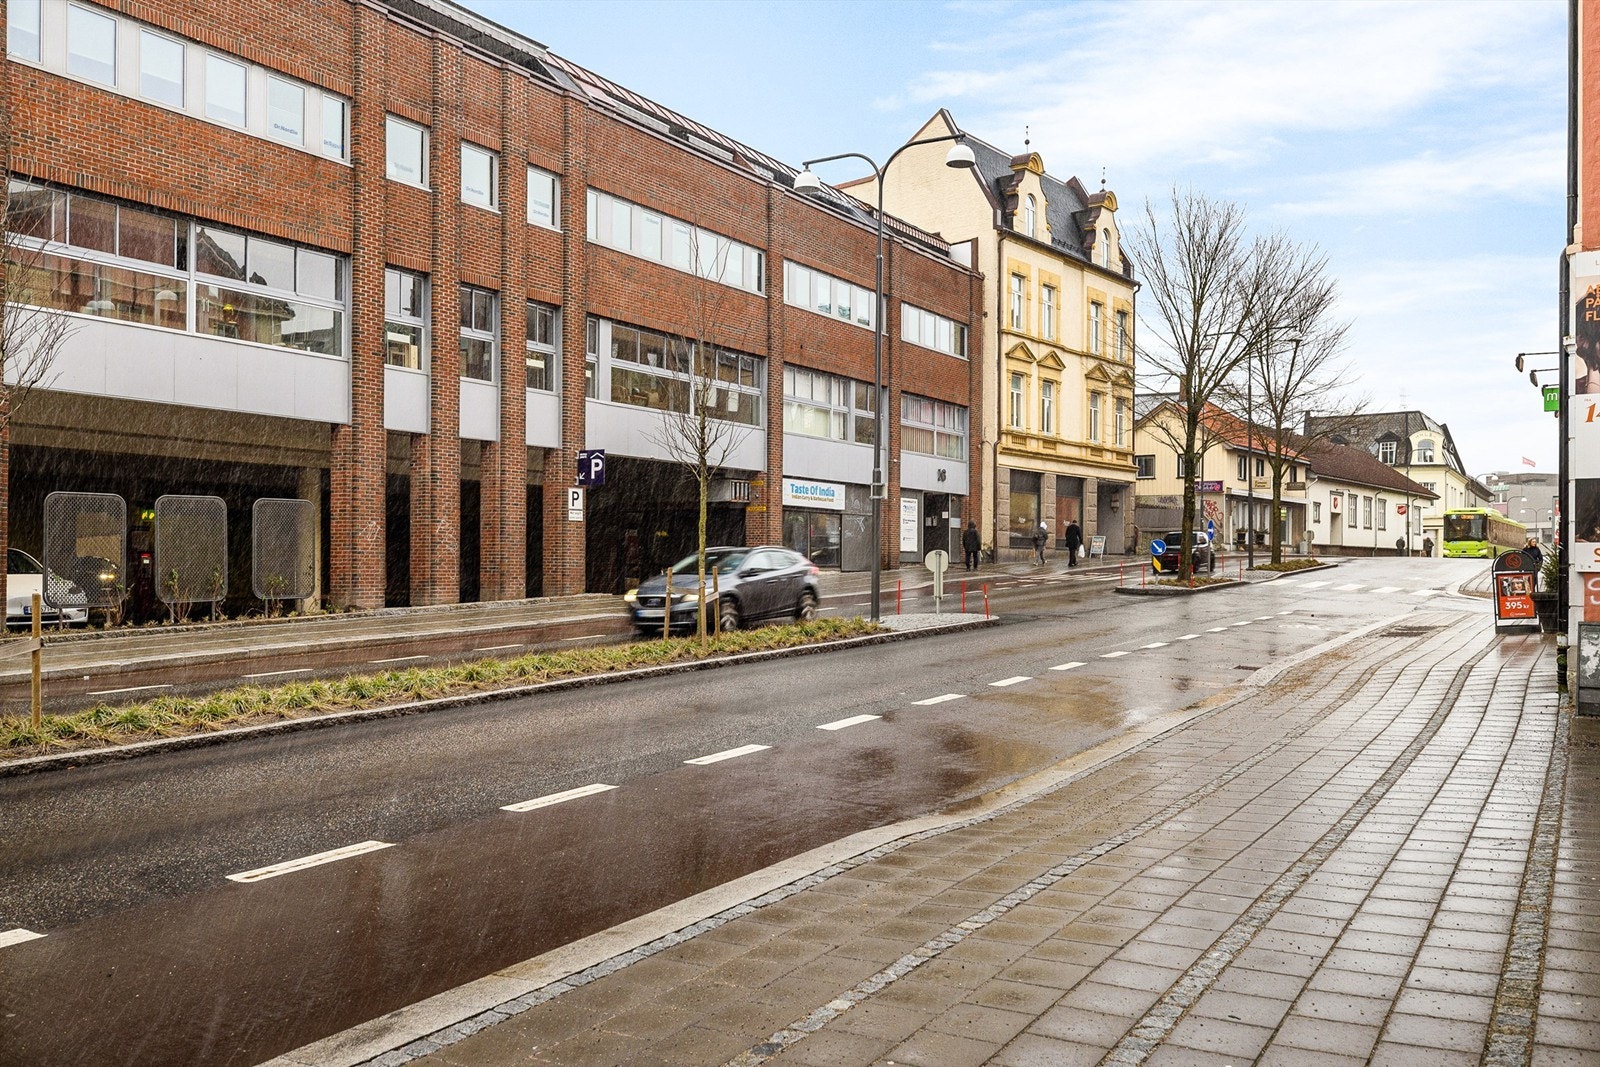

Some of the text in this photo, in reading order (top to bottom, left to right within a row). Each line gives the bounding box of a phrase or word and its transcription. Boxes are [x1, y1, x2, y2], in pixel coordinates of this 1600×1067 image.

[590, 459, 603, 479] P
[790, 483, 835, 498] Taste Of India
[571, 491, 580, 507] P
[1505, 601, 1522, 610] 395
